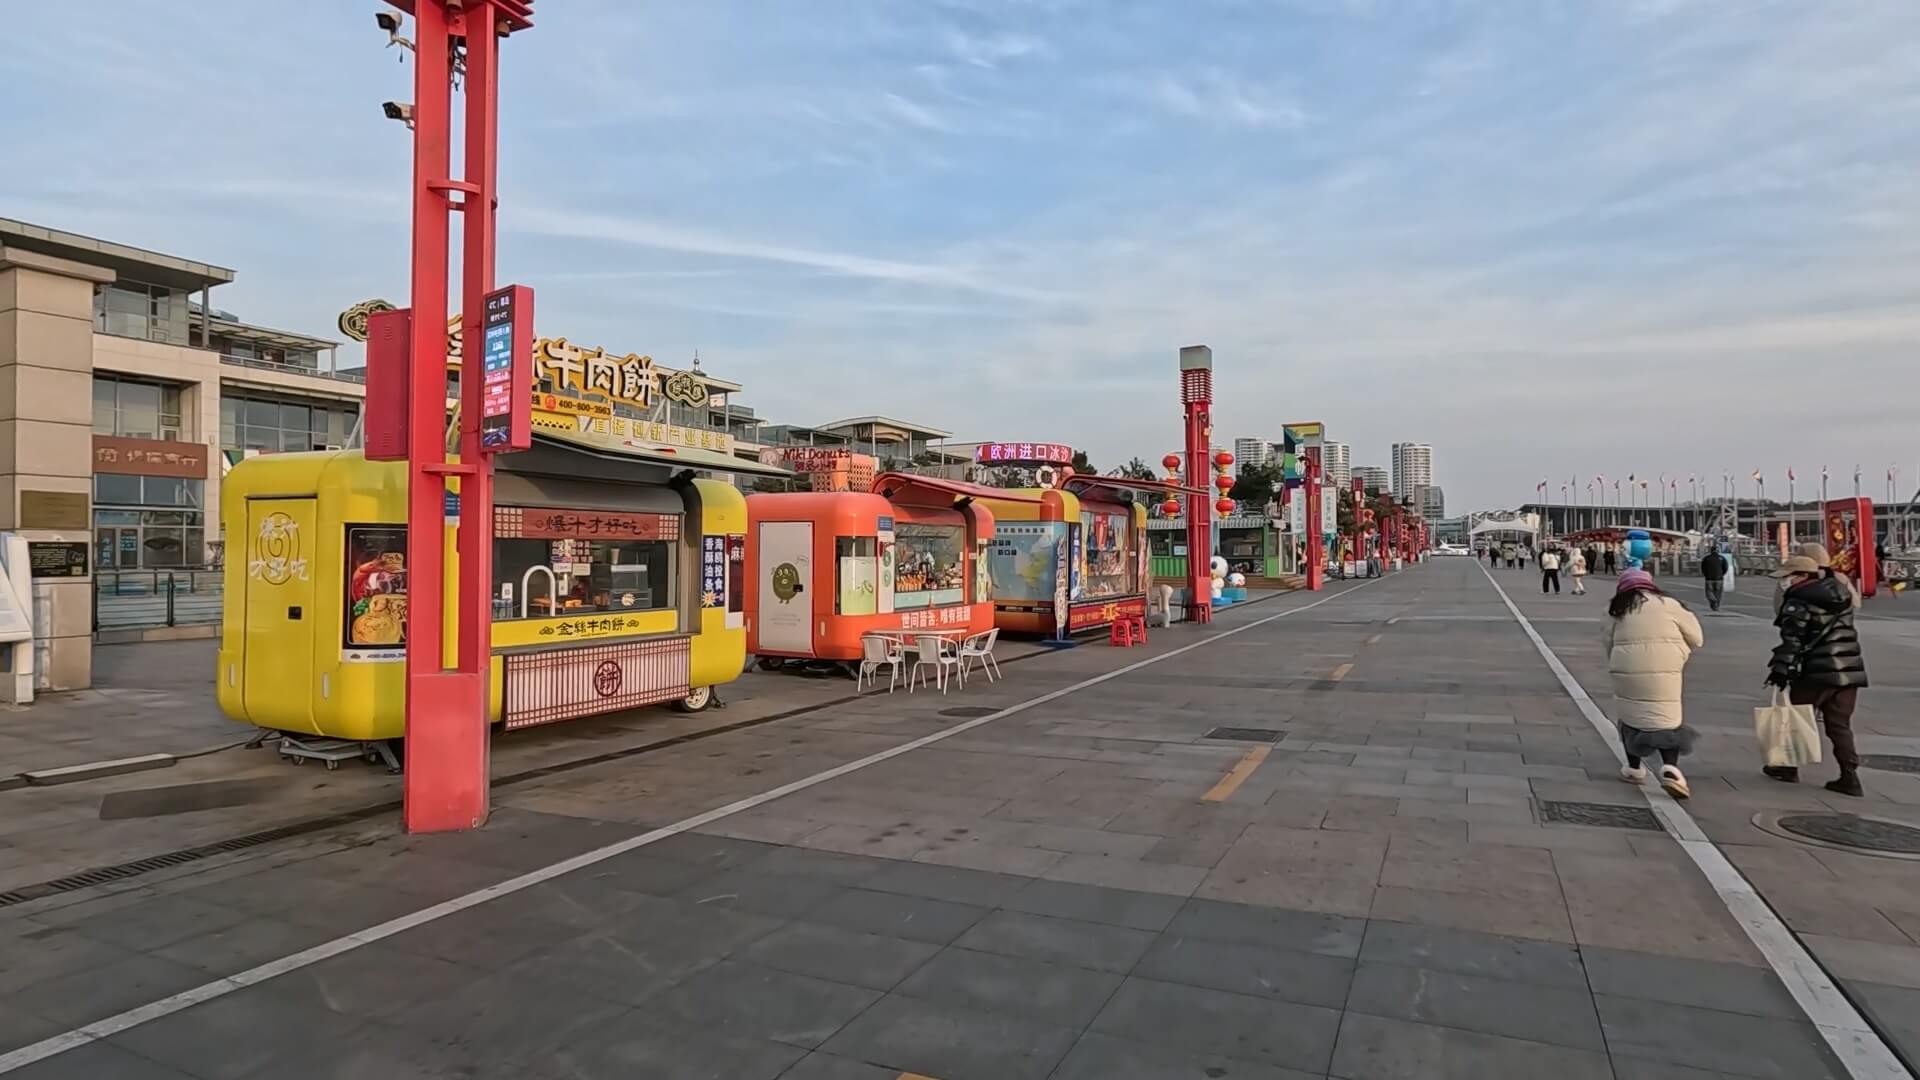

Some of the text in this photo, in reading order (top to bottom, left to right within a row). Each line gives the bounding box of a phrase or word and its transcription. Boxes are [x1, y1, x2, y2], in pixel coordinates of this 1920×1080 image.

[783, 448, 850, 461] Niki Donuts
[990, 443, 1069, 461] 欧洲进口冰沙
[544, 515, 642, 535] 爆汁才好吃
[250, 558, 309, 581] 才好吃
